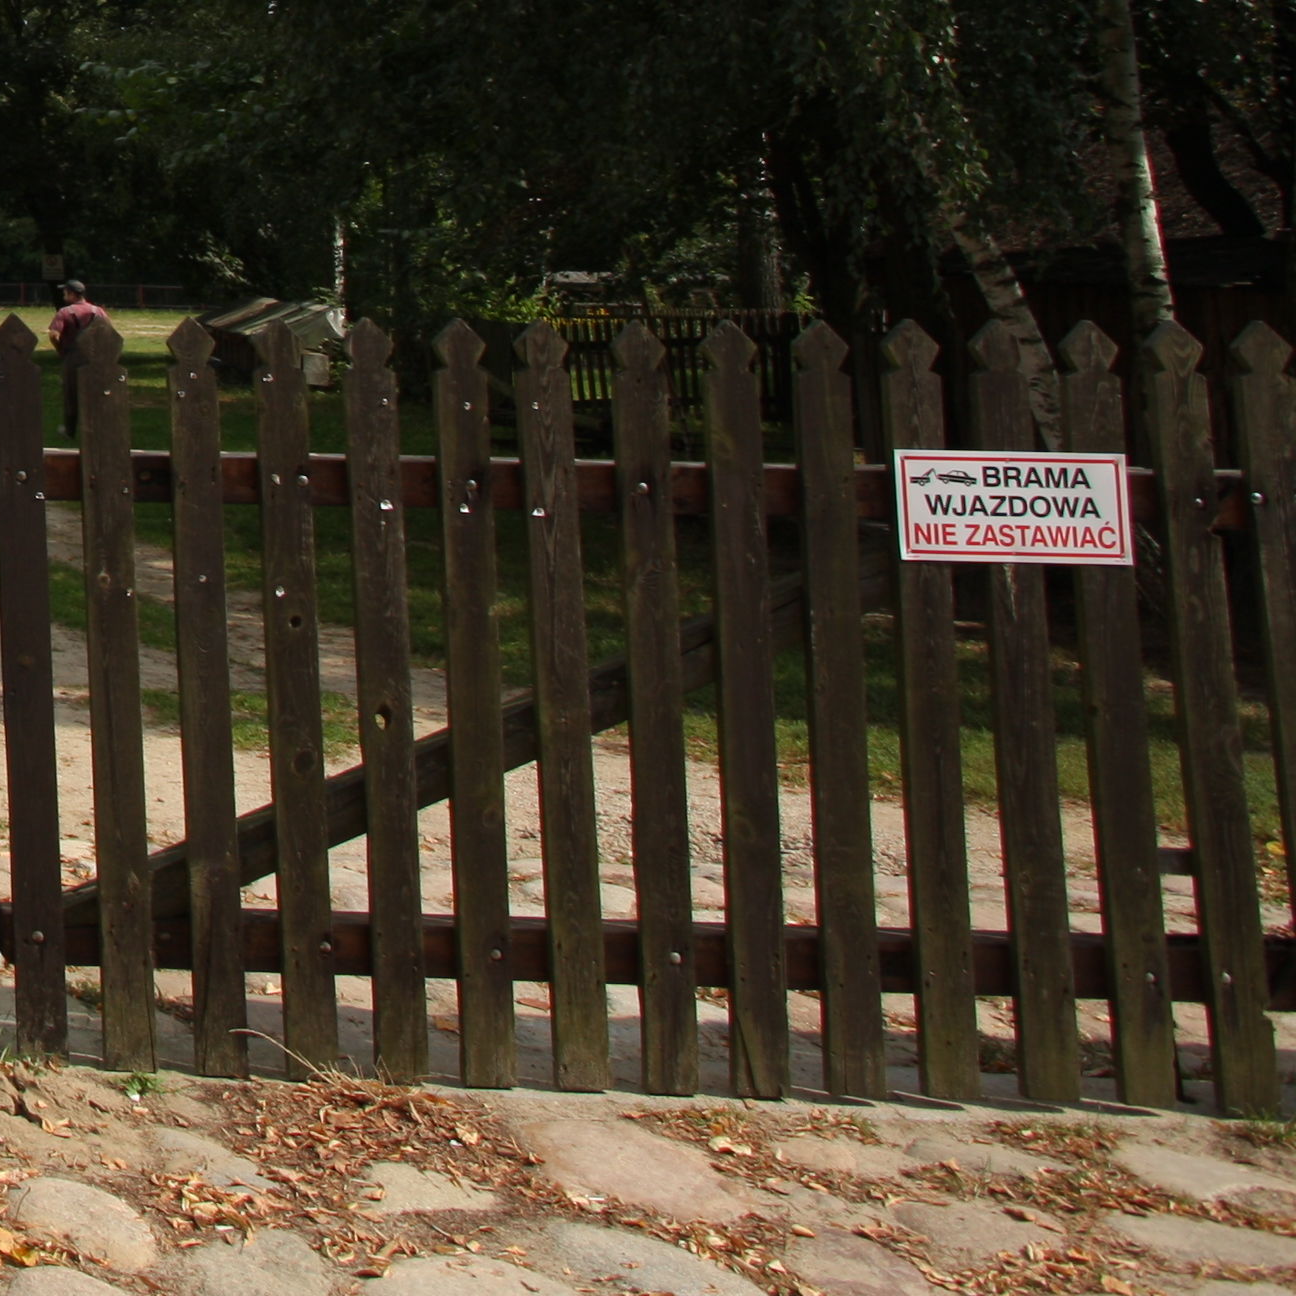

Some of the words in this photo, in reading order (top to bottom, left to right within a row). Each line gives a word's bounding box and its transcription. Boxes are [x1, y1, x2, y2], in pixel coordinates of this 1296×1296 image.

[982, 466, 1091, 489] BRAMA
[924, 494, 1101, 519] WJAZDOWA
[914, 522, 957, 546] NIE
[964, 521, 1117, 549] ZASTAWIAĆ
